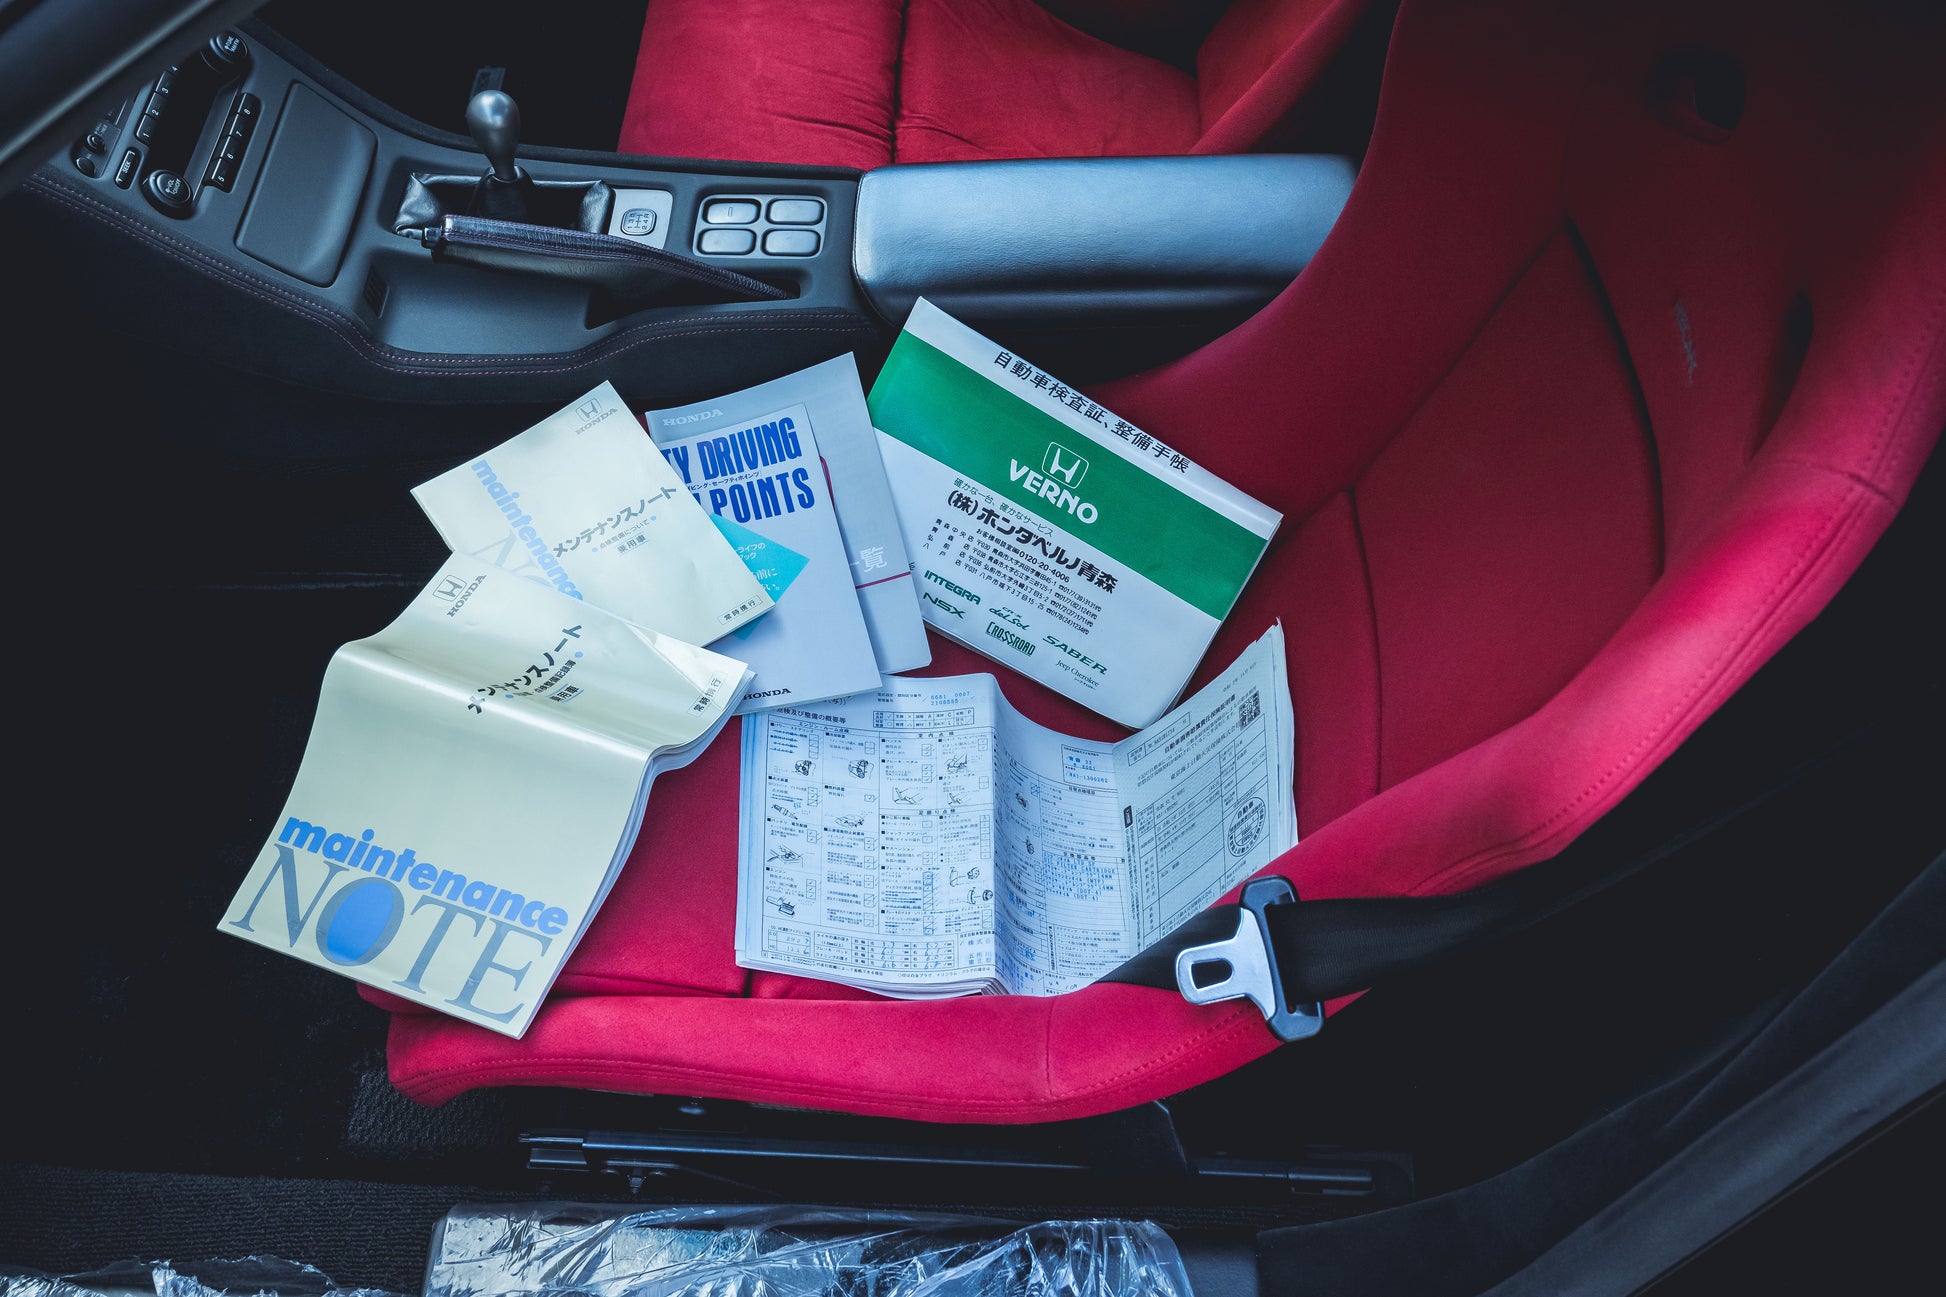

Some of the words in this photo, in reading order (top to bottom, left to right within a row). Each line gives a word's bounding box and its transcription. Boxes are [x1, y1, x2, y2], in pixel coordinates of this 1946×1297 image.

[122, 161, 132, 174] SEEK
[575, 405, 618, 435] HONDA
[663, 408, 724, 427] HONDA
[993, 351, 1191, 474] 自動車検査証、整備手帳
[696, 416, 803, 481] DRIVING
[708, 467, 816, 524] POINTS
[952, 476, 1055, 538] 確かな一台、確かなサービス
[1009, 458, 1099, 525] VERNO
[552, 485, 678, 558] メンテナンスノート
[1016, 549, 1071, 584] 0120-20-4006
[446, 574, 487, 617] HONDA
[921, 590, 966, 620] NSX
[923, 568, 982, 606] INTEGRA
[722, 598, 756, 621] 常時携行
[984, 620, 1037, 658] CROSSROAD
[1040, 632, 1109, 676] SABER
[1054, 658, 1072, 673] Jeep
[1069, 666, 1101, 688] Cherokee
[743, 688, 792, 701] HONDA
[277, 816, 569, 935] maintenance
[229, 843, 553, 1025] NOTE
